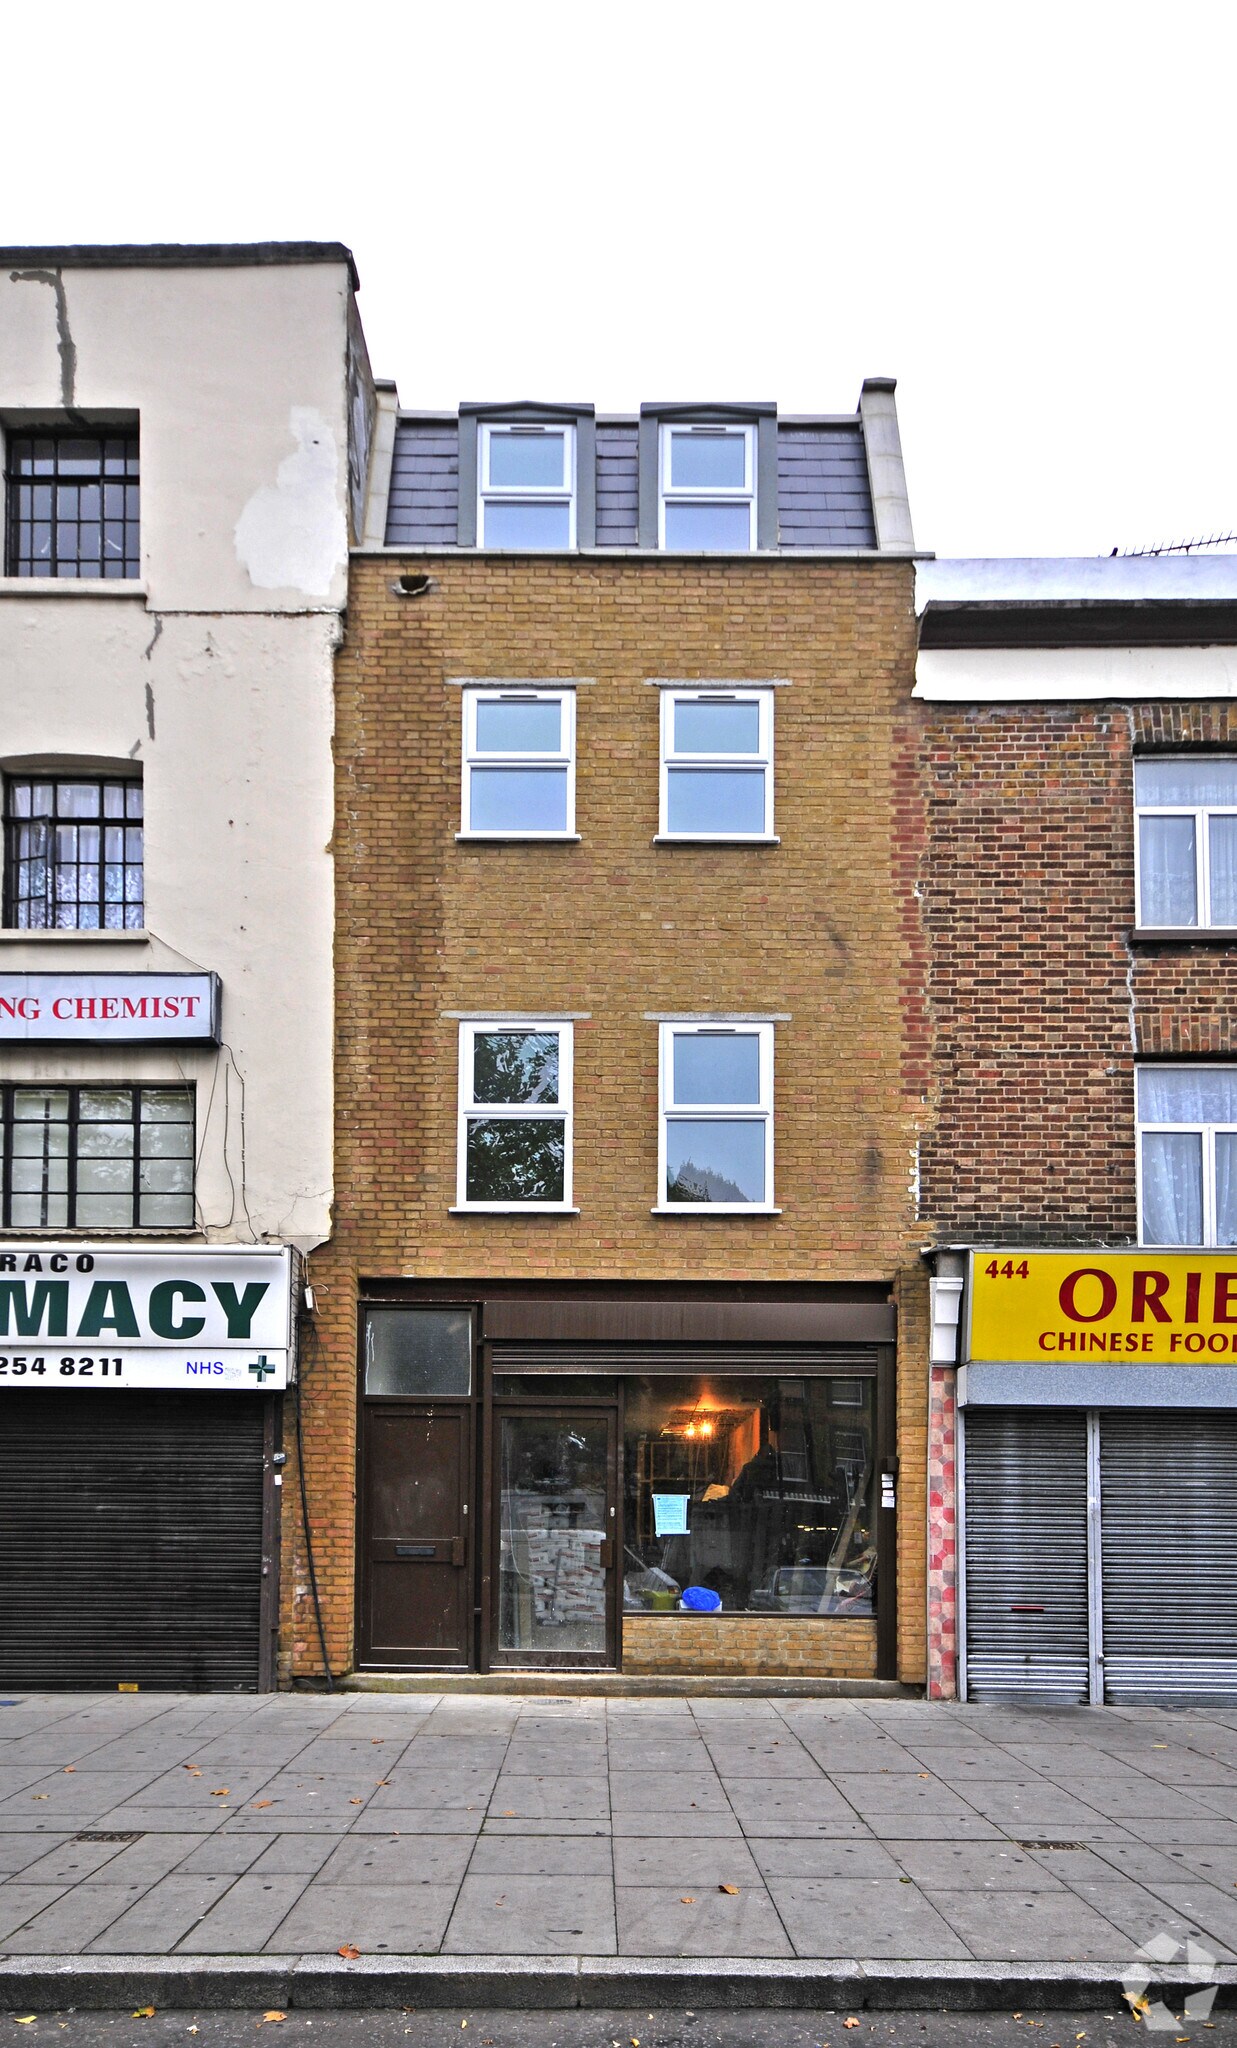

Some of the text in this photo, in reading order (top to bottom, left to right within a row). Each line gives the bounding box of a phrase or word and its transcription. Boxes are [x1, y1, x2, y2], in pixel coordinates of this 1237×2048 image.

[0, 996, 200, 1020] NG CHEMIST
[0, 1253, 95, 1274] RACO
[985, 1260, 1030, 1279] 444
[1058, 1268, 1237, 1324] ORIE
[0, 1280, 271, 1340] MACY
[1038, 1331, 1153, 1352] CHINESE
[59, 1357, 123, 1377] 8211
[186, 1361, 224, 1375] NHS
